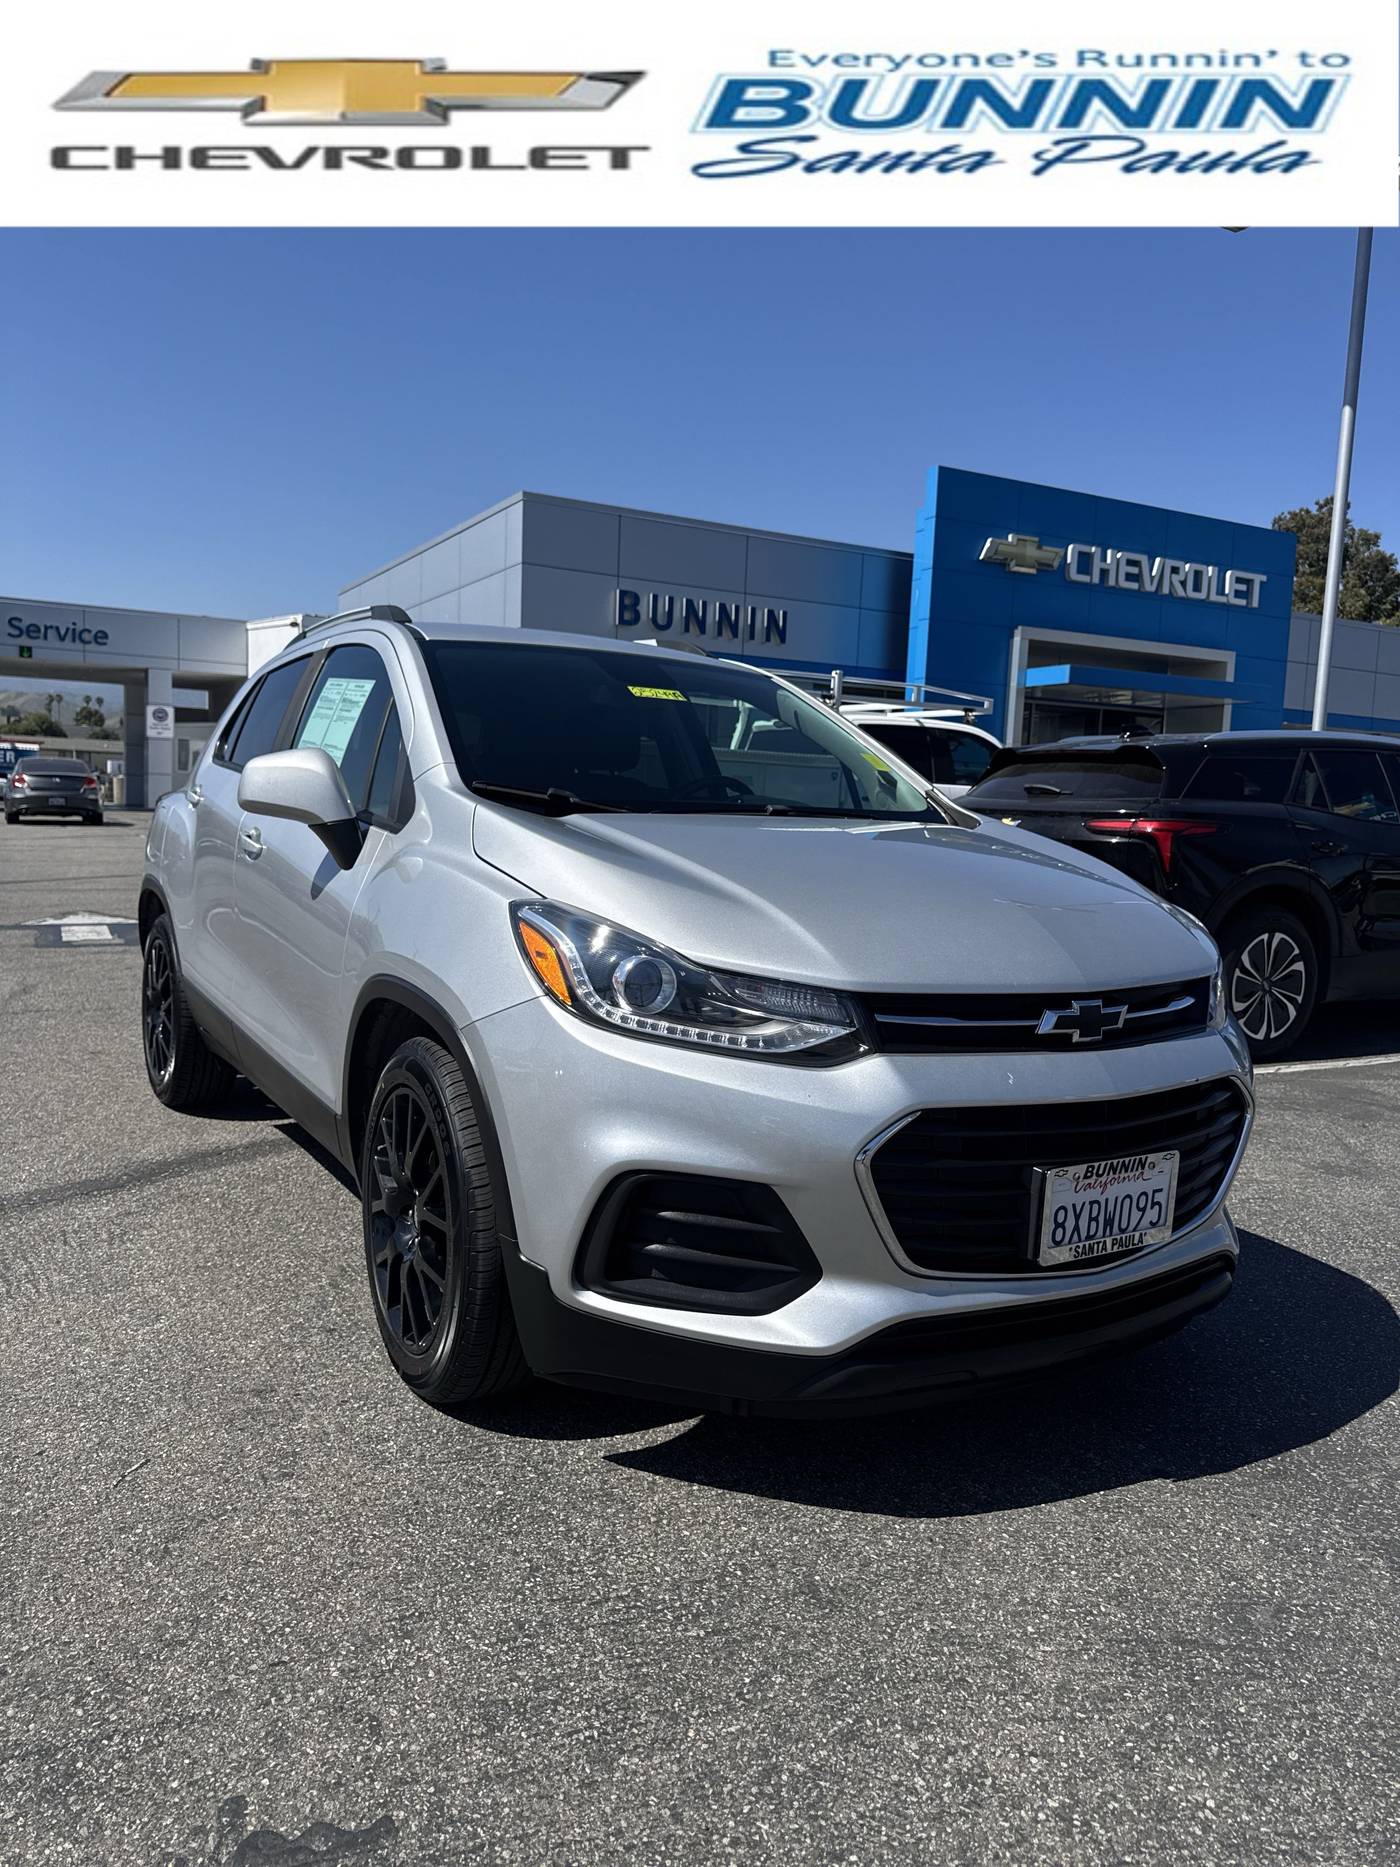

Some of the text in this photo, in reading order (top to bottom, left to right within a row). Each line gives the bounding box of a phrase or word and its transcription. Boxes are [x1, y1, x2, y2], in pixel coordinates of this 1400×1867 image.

[1066, 543, 1267, 608] CHEVROLET
[7, 616, 109, 646] Service
[616, 588, 787, 644] BUNNIN
[1074, 1171, 1152, 1195] California
[1083, 1156, 1148, 1179] BUNNIN
[1051, 1188, 1163, 1245] 8XBW095
